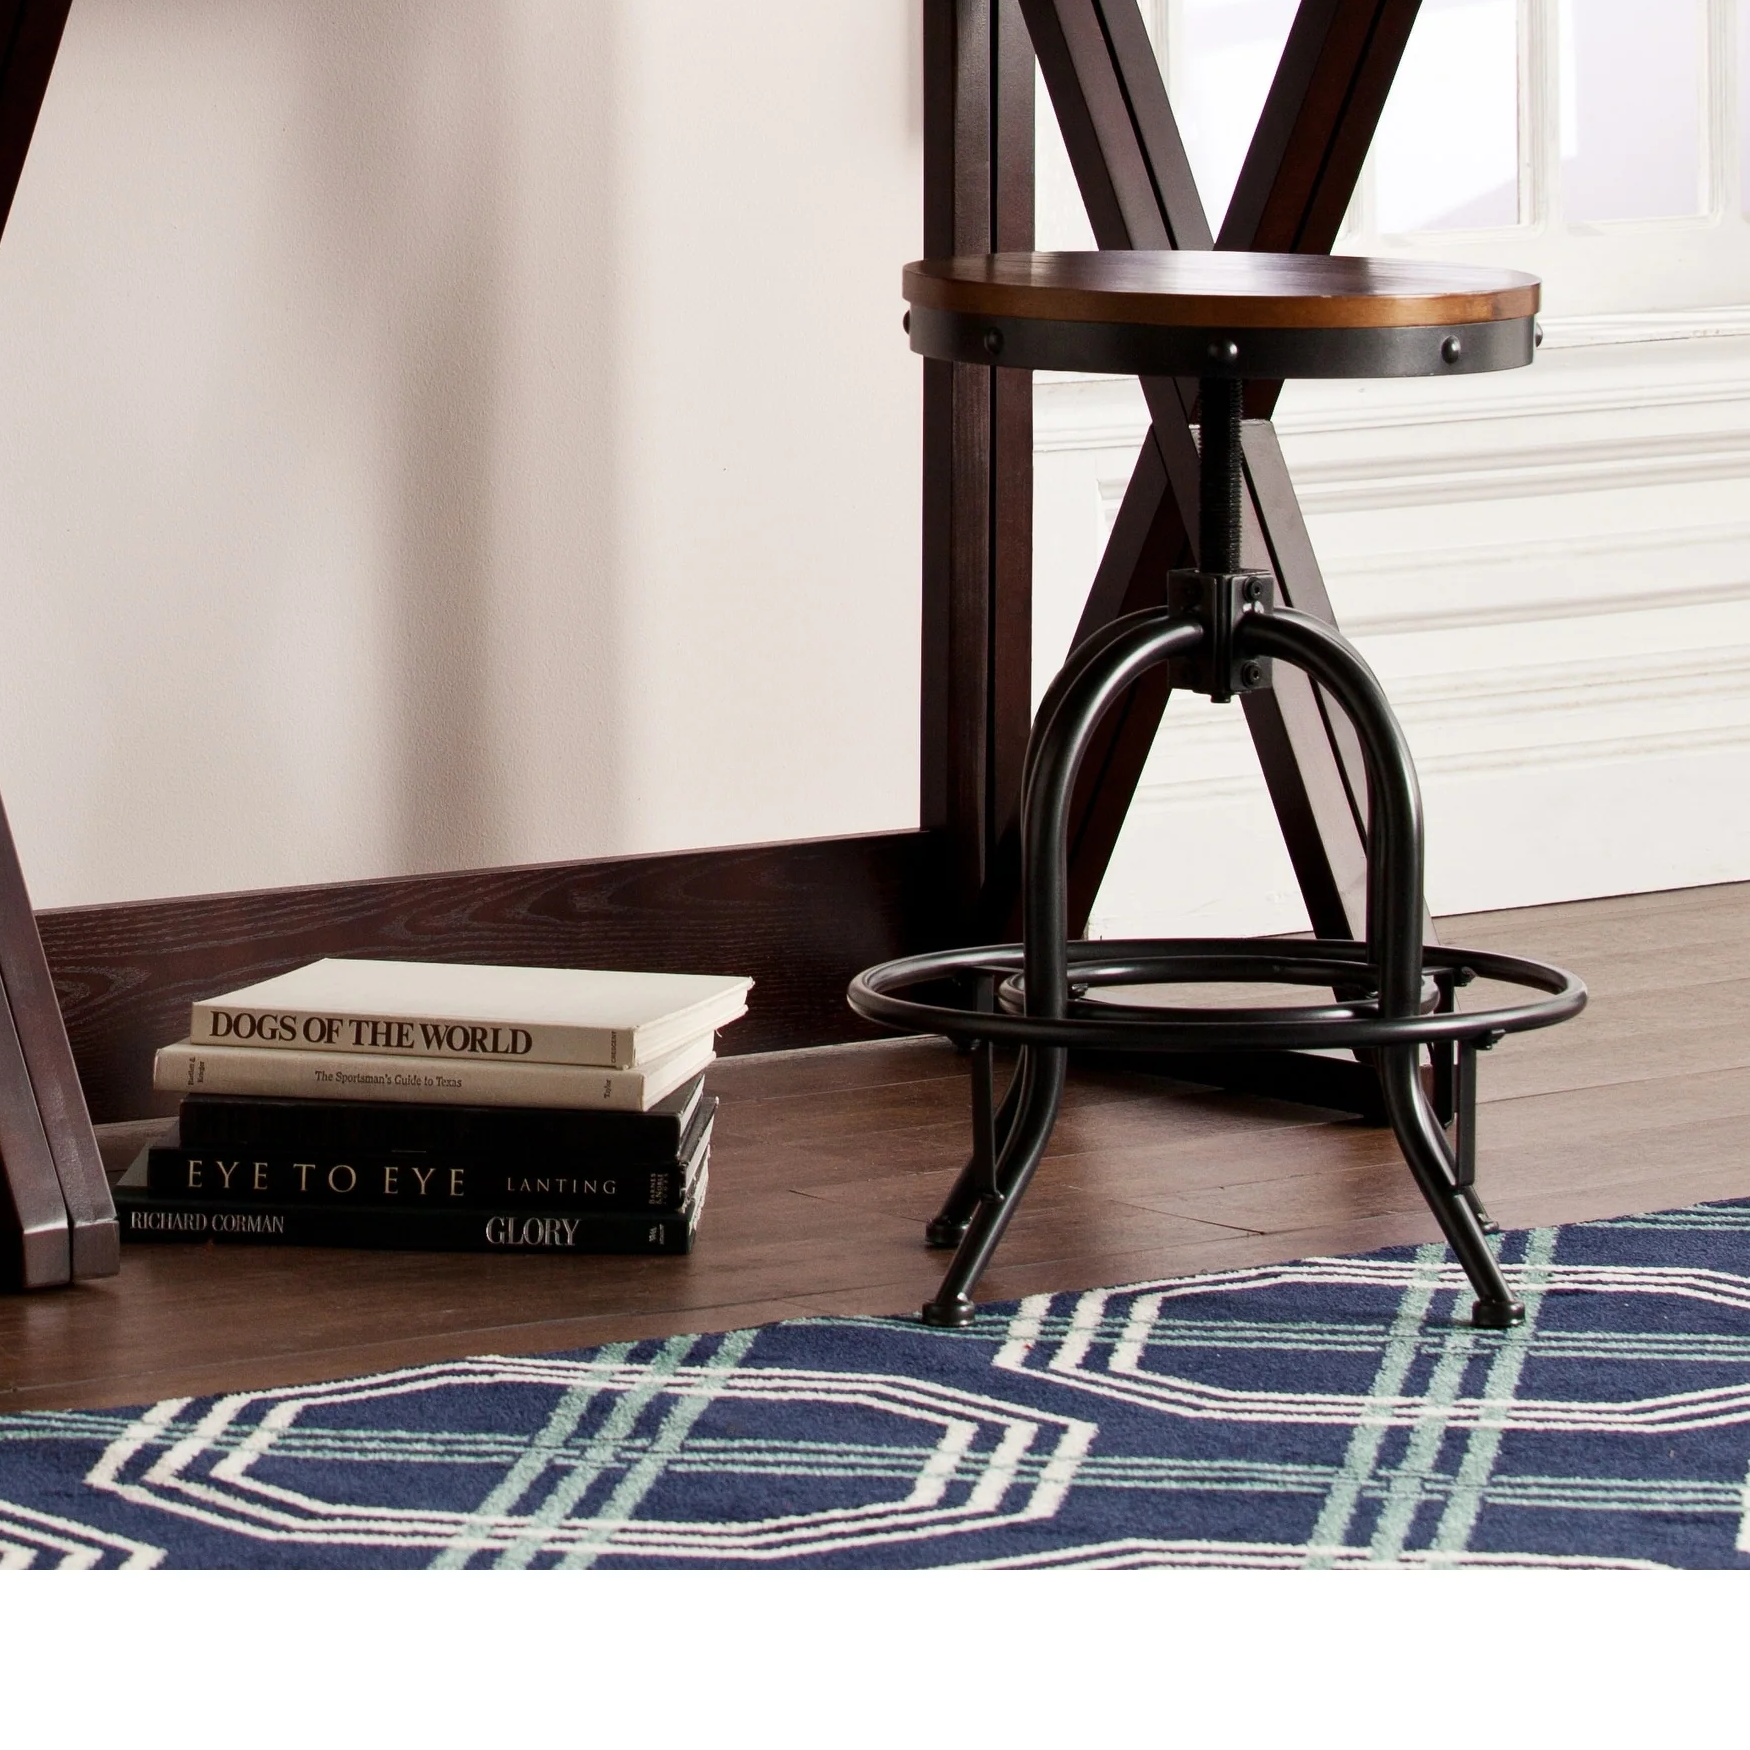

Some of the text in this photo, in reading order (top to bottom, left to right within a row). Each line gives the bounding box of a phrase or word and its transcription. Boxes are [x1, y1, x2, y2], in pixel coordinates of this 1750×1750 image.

[209, 1010, 533, 1055] DOGS OF THE WORLD
[314, 1070, 462, 1088] The Sportsman's Guide to Texas
[187, 1159, 465, 1197] EYE TO EYE
[507, 1177, 617, 1195] LANTING
[130, 1211, 285, 1234] RICHARD CORMAN
[485, 1215, 582, 1247] GLORY
